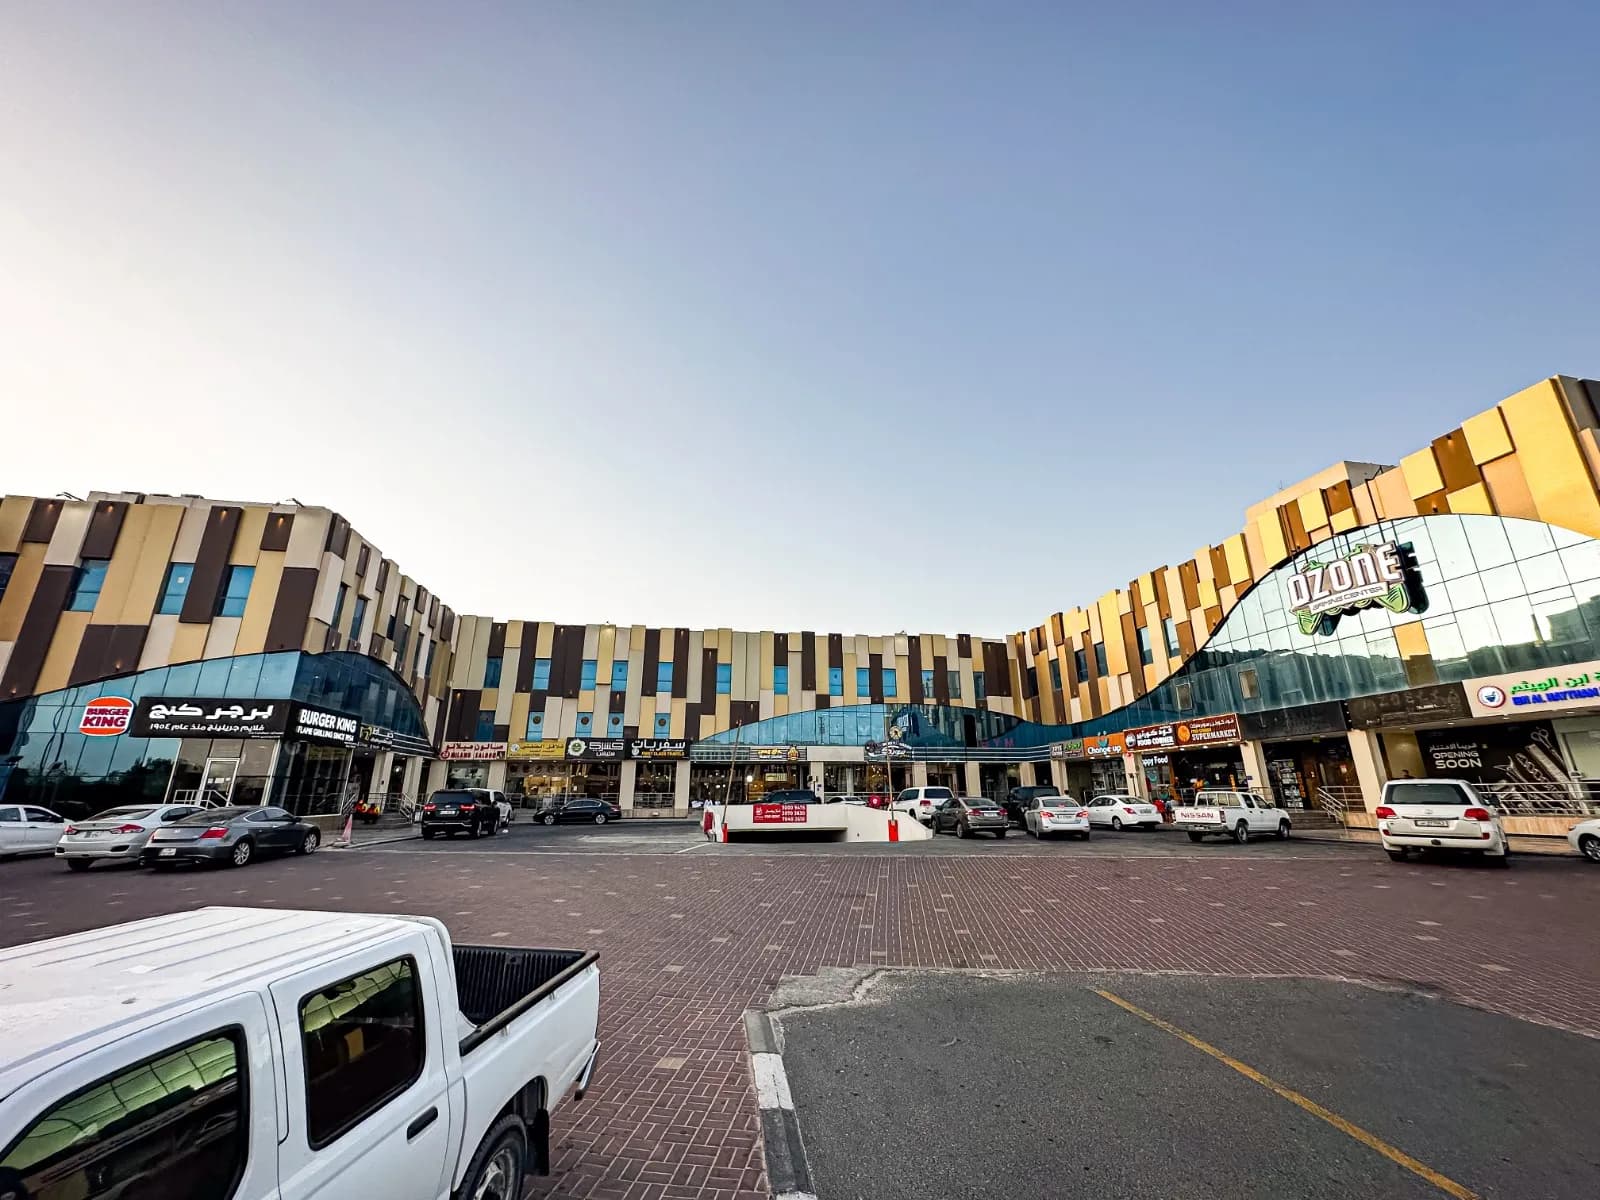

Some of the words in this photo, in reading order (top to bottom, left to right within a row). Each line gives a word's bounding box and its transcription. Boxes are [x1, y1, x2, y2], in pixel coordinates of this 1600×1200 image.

[1287, 540, 1404, 607] OZONE
[1343, 585, 1384, 602] CENTER
[1511, 677, 1559, 695] الهيثم
[1565, 673, 1590, 688] ابن
[86, 708, 130, 716] BURGER
[149, 703, 203, 719] كنج
[205, 705, 274, 721] برجر
[82, 716, 127, 727] KING
[300, 709, 336, 729] BURGER
[336, 717, 357, 733] KING
[1191, 729, 1236, 741] SUPERMARKET
[1137, 739, 1151, 747] FOOD
[1152, 736, 1174, 745] CORNER
[1087, 746, 1111, 755] Change
[1112, 745, 1121, 753] up
[1432, 751, 1479, 760] OPENING
[1154, 756, 1168, 765] Food
[1434, 758, 1482, 769] SOON
